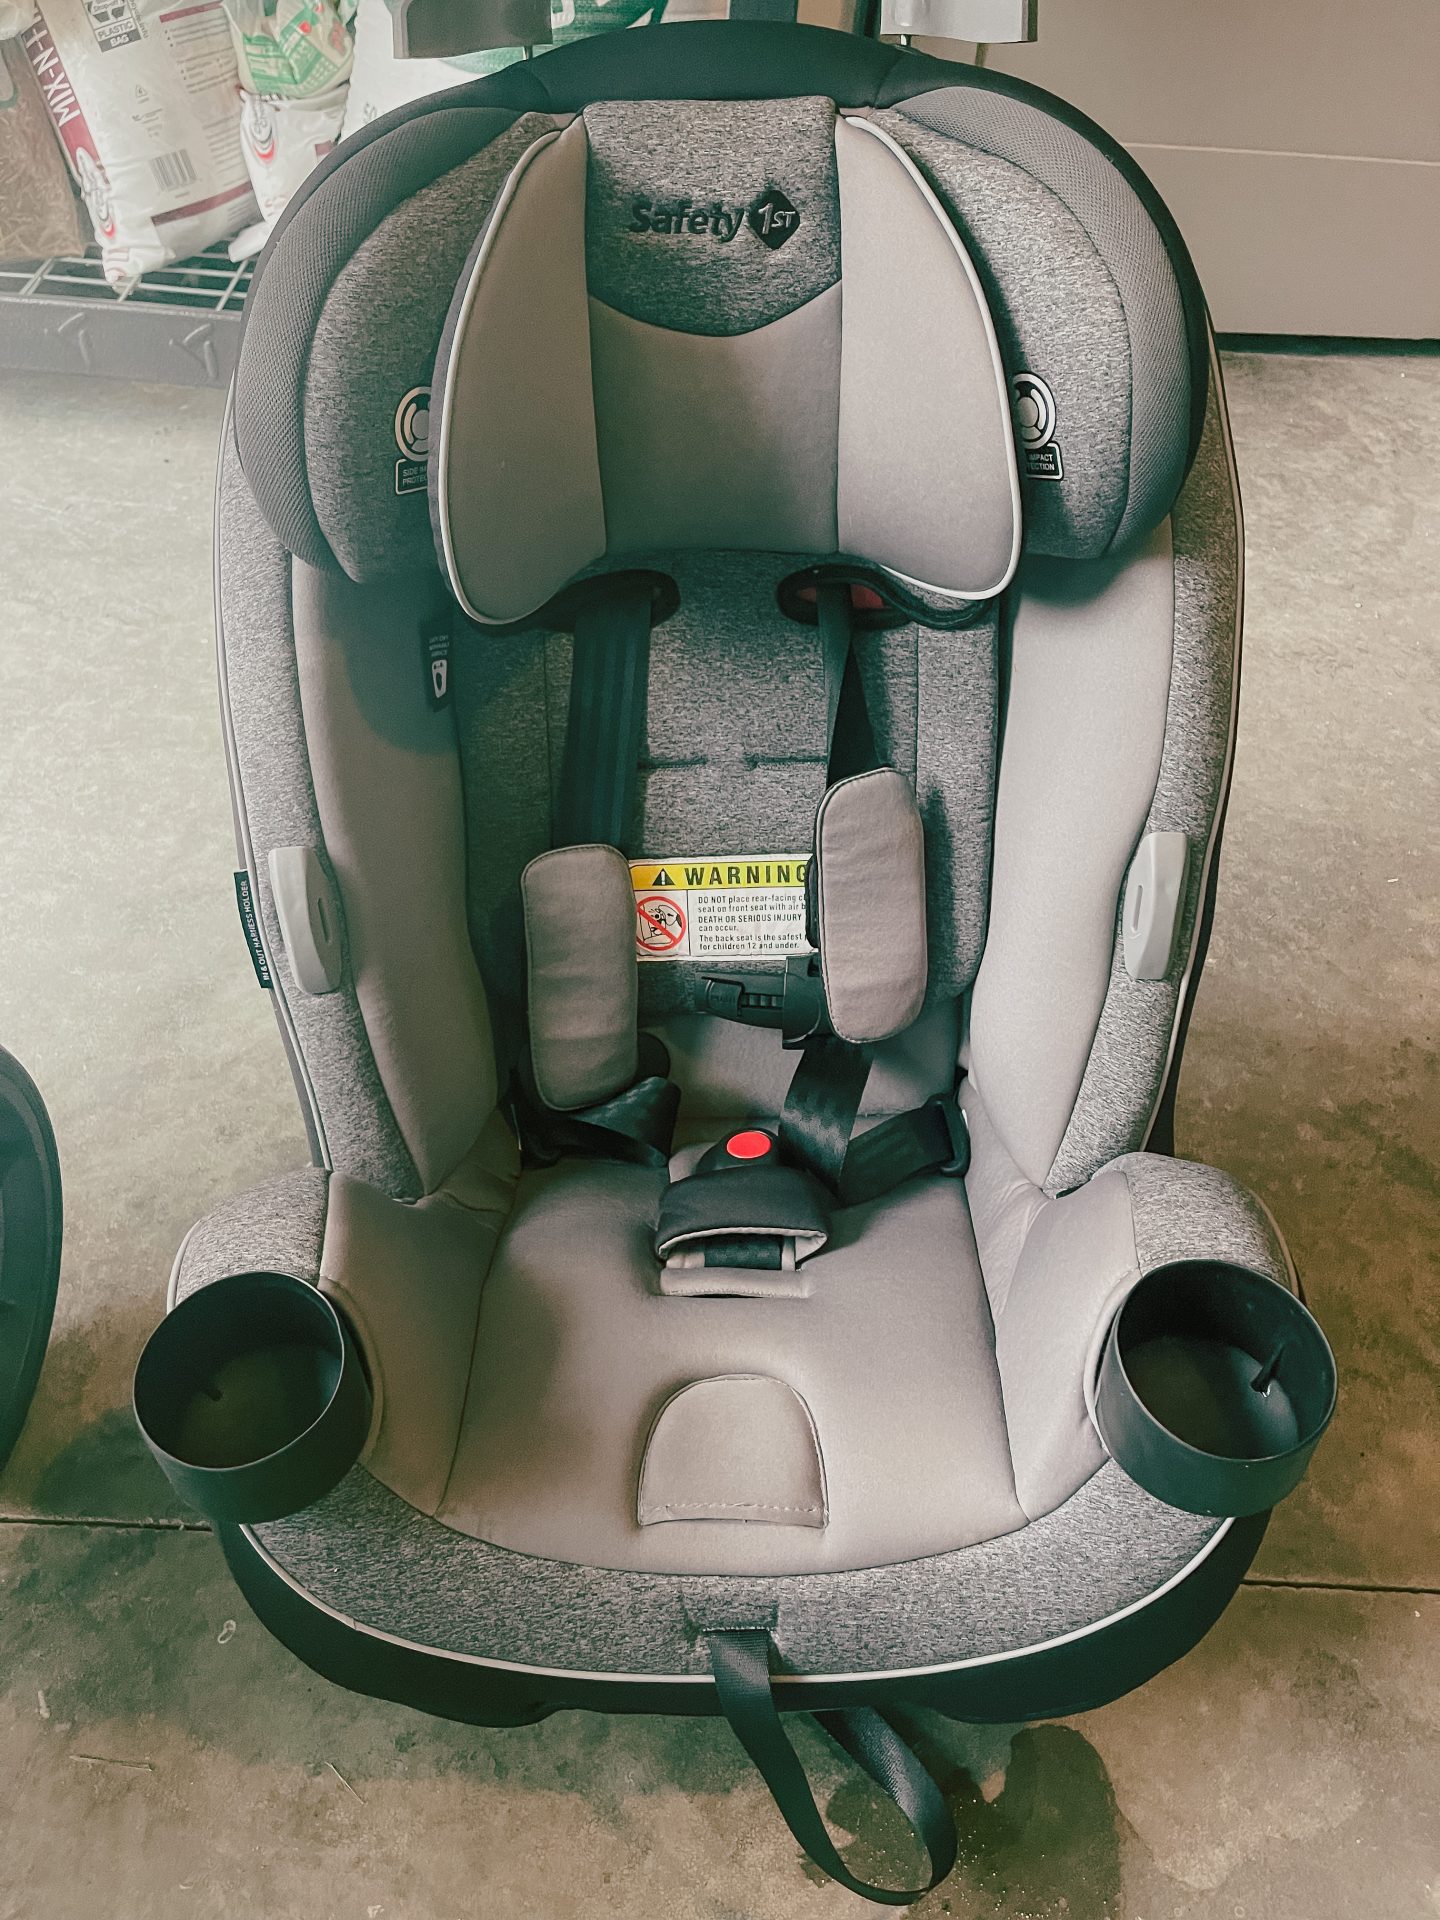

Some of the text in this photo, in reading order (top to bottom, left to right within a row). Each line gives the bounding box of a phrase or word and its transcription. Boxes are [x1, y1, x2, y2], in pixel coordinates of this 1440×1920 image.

[98, 21, 133, 39] PLASTIC
[110, 34, 130, 47] BAG
[630, 199, 744, 243] Safety
[403, 467, 418, 476] SIDE
[684, 864, 806, 886] WARNING
[240, 880, 252, 912] HOLDER
[698, 896, 708, 904] DO
[711, 895, 726, 903] NOT
[728, 895, 749, 904] place
[751, 894, 796, 904] rear-facing
[698, 905, 715, 913] seat
[728, 904, 748, 912] front
[750, 903, 767, 911] seat
[769, 902, 785, 911] with
[788, 902, 799, 910] air
[698, 913, 802, 923] DEATH OR SERIOUS INJURY
[246, 914, 260, 948] HARNESS
[699, 934, 713, 942] The
[715, 934, 734, 942] back
[755, 933, 761, 941] is
[763, 933, 775, 941] the
[256, 949, 266, 965] OUT
